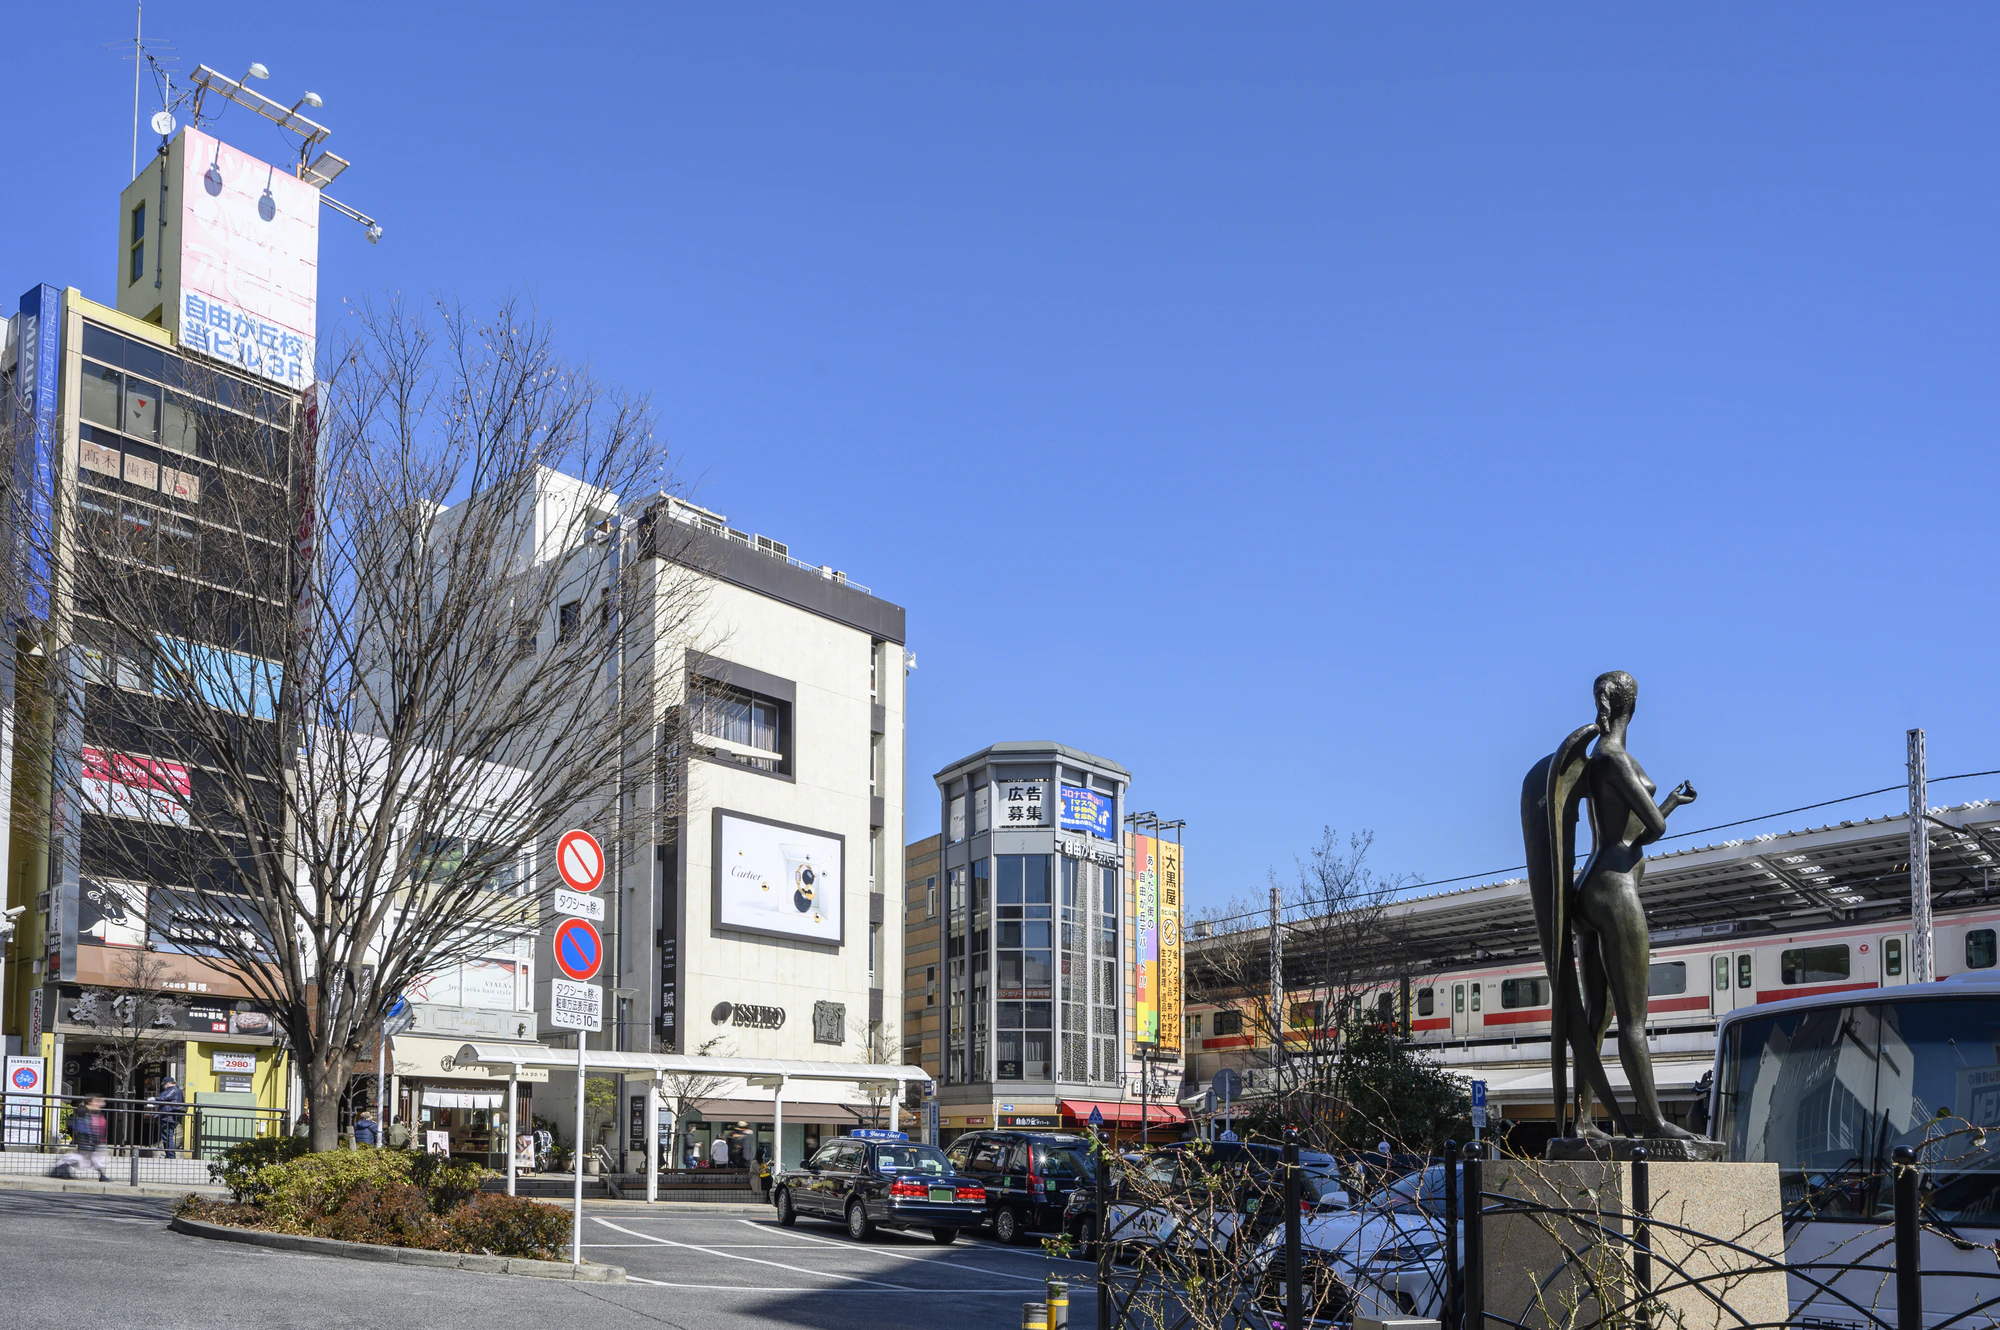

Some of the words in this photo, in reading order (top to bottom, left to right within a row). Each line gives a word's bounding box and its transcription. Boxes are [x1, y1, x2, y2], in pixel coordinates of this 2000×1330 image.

[185, 295, 303, 361] 自由が丘校
[23, 314, 37, 414] MIZUHO
[1008, 786, 1042, 801] 広告
[1008, 806, 1042, 821] 募集
[731, 865, 763, 882] Cartier
[1165, 854, 1177, 906] 大黒屋
[1146, 855, 1154, 929] あなたの街の
[558, 894, 601, 916] タクシーを除く
[482, 986, 493, 994] hair
[495, 987, 512, 996] style
[556, 983, 599, 1000] タクシーを除く
[556, 997, 598, 1014] 駐車方法表示線内
[732, 1003, 786, 1029] ISSEIDO
[225, 1060, 249, 1068] 2980
[1475, 1083, 1484, 1104] P
